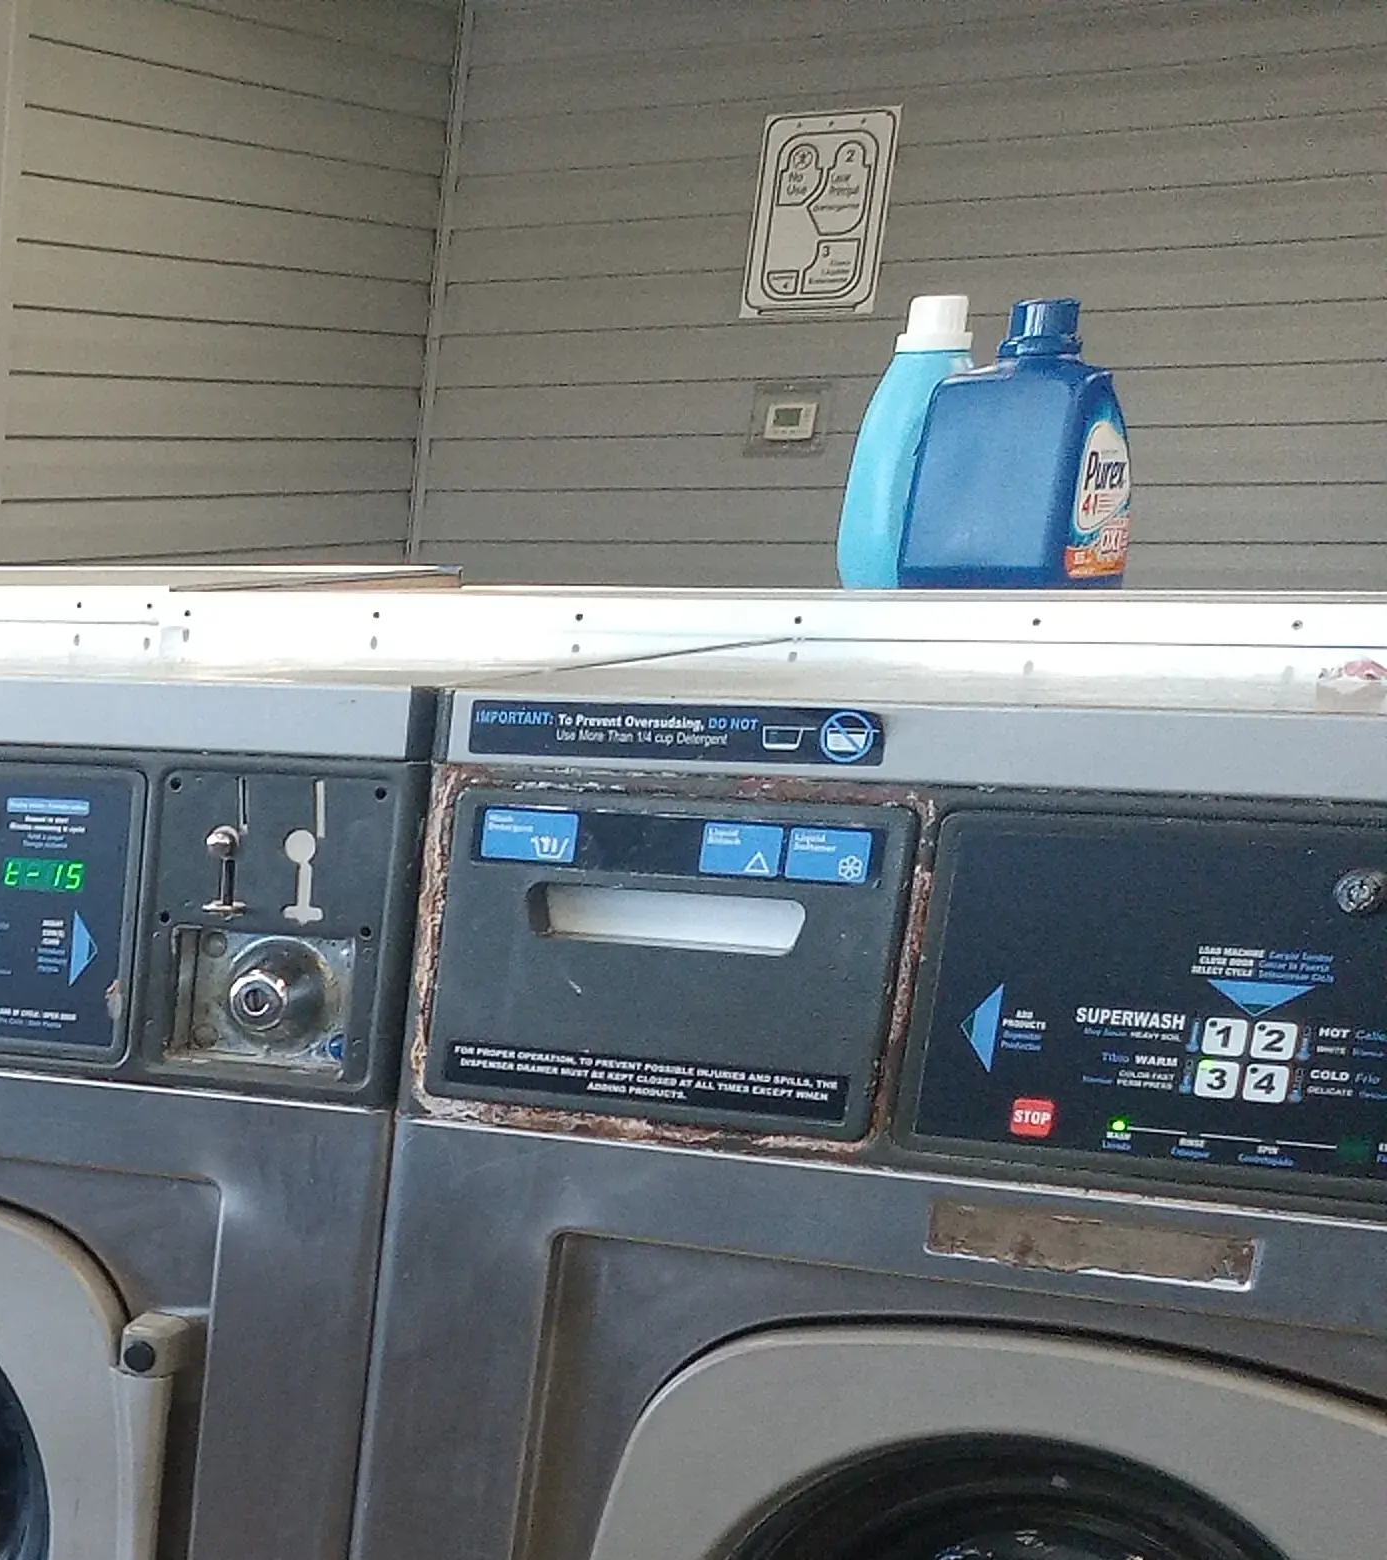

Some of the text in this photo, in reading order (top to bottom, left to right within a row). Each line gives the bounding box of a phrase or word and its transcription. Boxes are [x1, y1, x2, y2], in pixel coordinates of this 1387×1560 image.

[1084, 451, 1126, 491] Purex
[476, 709, 759, 732] IMPORTANT: To Prevent Oversudsing, DO NOT
[556, 728, 576, 741] Use
[578, 729, 604, 742] More
[607, 730, 634, 743] Than
[654, 734, 674, 745] cup
[676, 732, 728, 747] Detergent
[1002, 1018, 1047, 1030] PRODUCTS
[1075, 1007, 1186, 1031] SUPERWASH
[1216, 1025, 1286, 1052] 1 2
[1318, 1027, 1351, 1039] HOT
[454, 1045, 475, 1055] FOR
[477, 1047, 516, 1060] PROPER
[517, 1052, 577, 1066] OPERATION,
[580, 1057, 593, 1067] TO
[594, 1059, 642, 1071] PREVENT
[644, 1063, 695, 1077] POSSIBLE
[696, 1068, 746, 1081] INJURIES
[748, 1073, 771, 1083] AND
[816, 1080, 838, 1090] THE
[1135, 1054, 1178, 1067] WARM
[460, 1058, 828, 1101] DISPENSER DRAWER MUST BE KEPT CLOSED AT ALL TIMES EXCEPT WHEN
[1206, 1068, 1276, 1095] 3 4
[1310, 1069, 1350, 1082] COLD
[587, 1081, 687, 1099] ADDING PRODUCTS.
[1307, 1085, 1353, 1097] DELICATE
[1013, 1109, 1052, 1126] STOP
